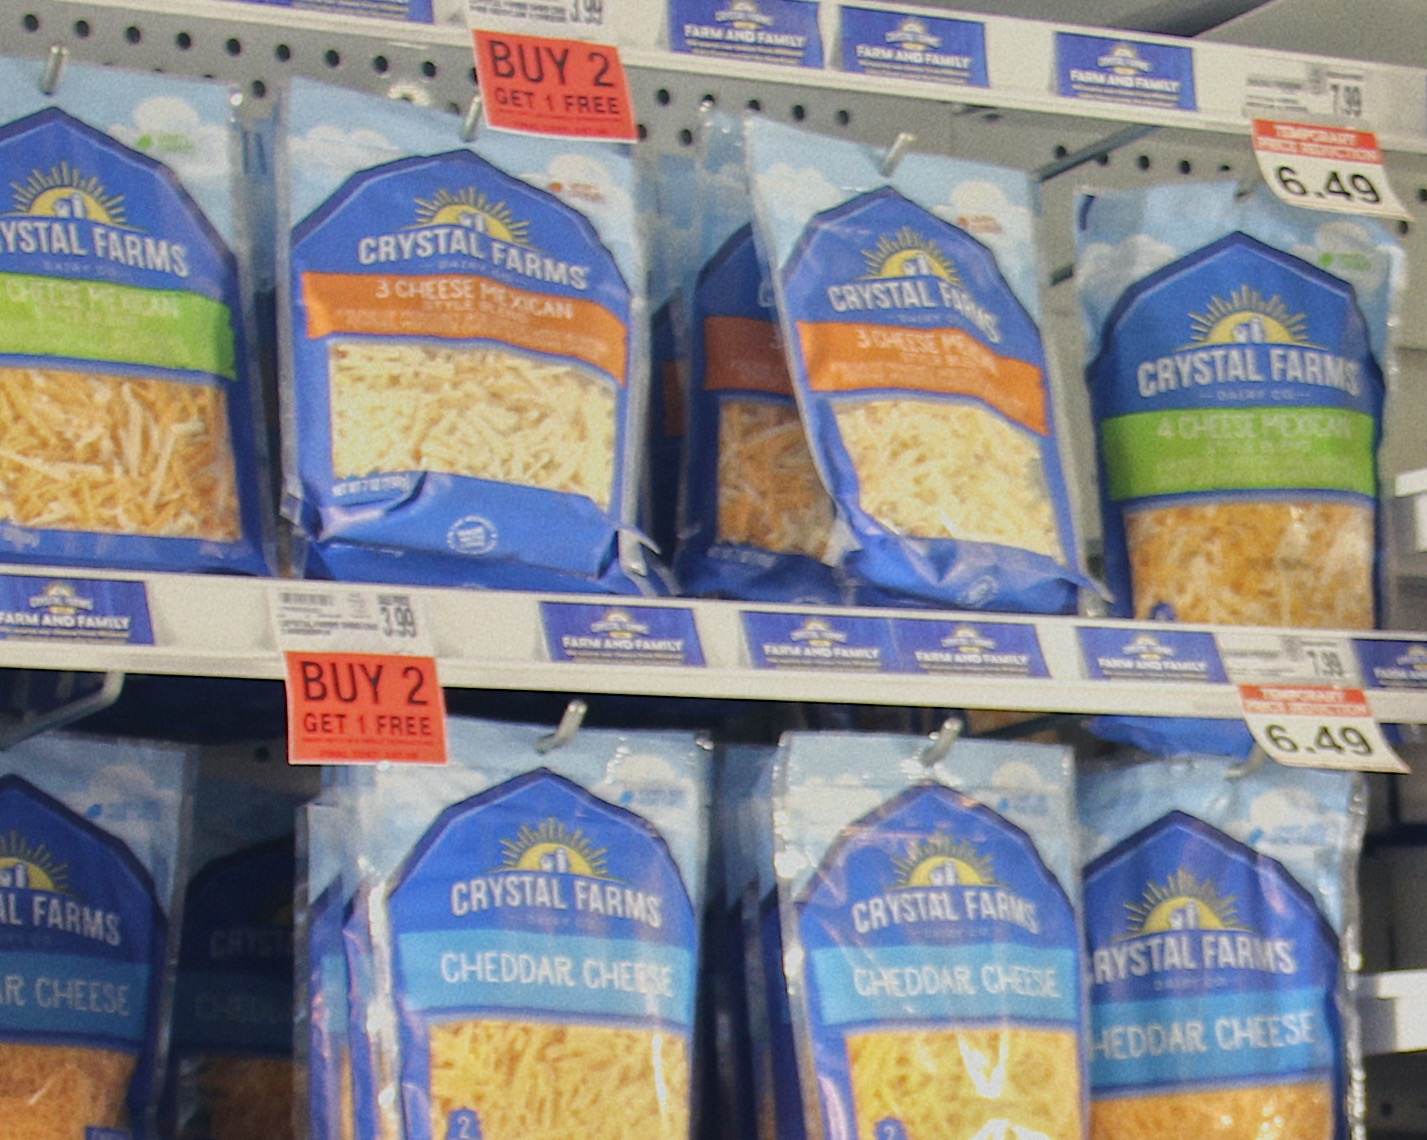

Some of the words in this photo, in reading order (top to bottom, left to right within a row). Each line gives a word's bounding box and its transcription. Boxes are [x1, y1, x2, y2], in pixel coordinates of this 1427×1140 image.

[684, 24, 722, 39] FARM
[725, 29, 754, 43] AND
[757, 32, 806, 48] FAMILY
[489, 40, 569, 85] BUY
[588, 51, 615, 88] 2
[856, 44, 893, 60] FARM
[895, 51, 923, 64] AND
[924, 53, 972, 69] FAMILY
[494, 87, 535, 110] GET
[545, 94, 555, 112] 1
[565, 94, 620, 115] FREE
[1277, 165, 1381, 204] 6.49
[0, 219, 88, 257] YSTAL
[92, 225, 190, 279] FARMS
[357, 226, 487, 267] CRYSTAL
[491, 242, 594, 292] FARMS
[374, 279, 391, 299] 3
[395, 278, 475, 301] CHEESE
[480, 282, 576, 320] MEXICAN
[827, 280, 937, 313] CRYSTAL
[1136, 348, 1264, 398] CRYSTAL
[1269, 348, 1362, 398] FARMS
[0, 611, 39, 626] FARM
[41, 613, 76, 629] AND
[77, 614, 131, 631] FAMILY
[378, 606, 417, 639] 3.99
[561, 635, 601, 650] FARM
[603, 637, 633, 651] AND
[635, 638, 683, 652] FAMILY
[763, 643, 801, 656] FARM
[803, 646, 831, 658] AND
[833, 646, 880, 660] FAMILY
[914, 650, 952, 664] FARM
[954, 652, 982, 665] AND
[983, 653, 1030, 667] FAMILY
[300, 660, 384, 705] BUY
[401, 665, 428, 706] 2
[304, 712, 346, 734] GET
[357, 714, 366, 736] 1
[377, 714, 433, 737] FREE
[1265, 723, 1375, 757] 6.49
[32, 894, 121, 947] FARMS
[450, 875, 568, 918] CRYSTAL
[573, 879, 664, 929] FARMS
[851, 885, 960, 935] CRYSTAL
[965, 890, 1041, 935] FARMS
[440, 951, 576, 988] CHEDDAR
[582, 958, 675, 999] CHEESE
[1090, 934, 1198, 986] RYSTAL
[1202, 935, 1297, 976] FARMS
[34, 976, 131, 1017] CHEESE
[853, 965, 977, 998] CHEDDAR
[981, 964, 1063, 999] CHEESE
[1091, 1018, 1208, 1062] HEDDAR
[1214, 1010, 1317, 1051] CHEESE
[457, 1115, 470, 1140] 2
